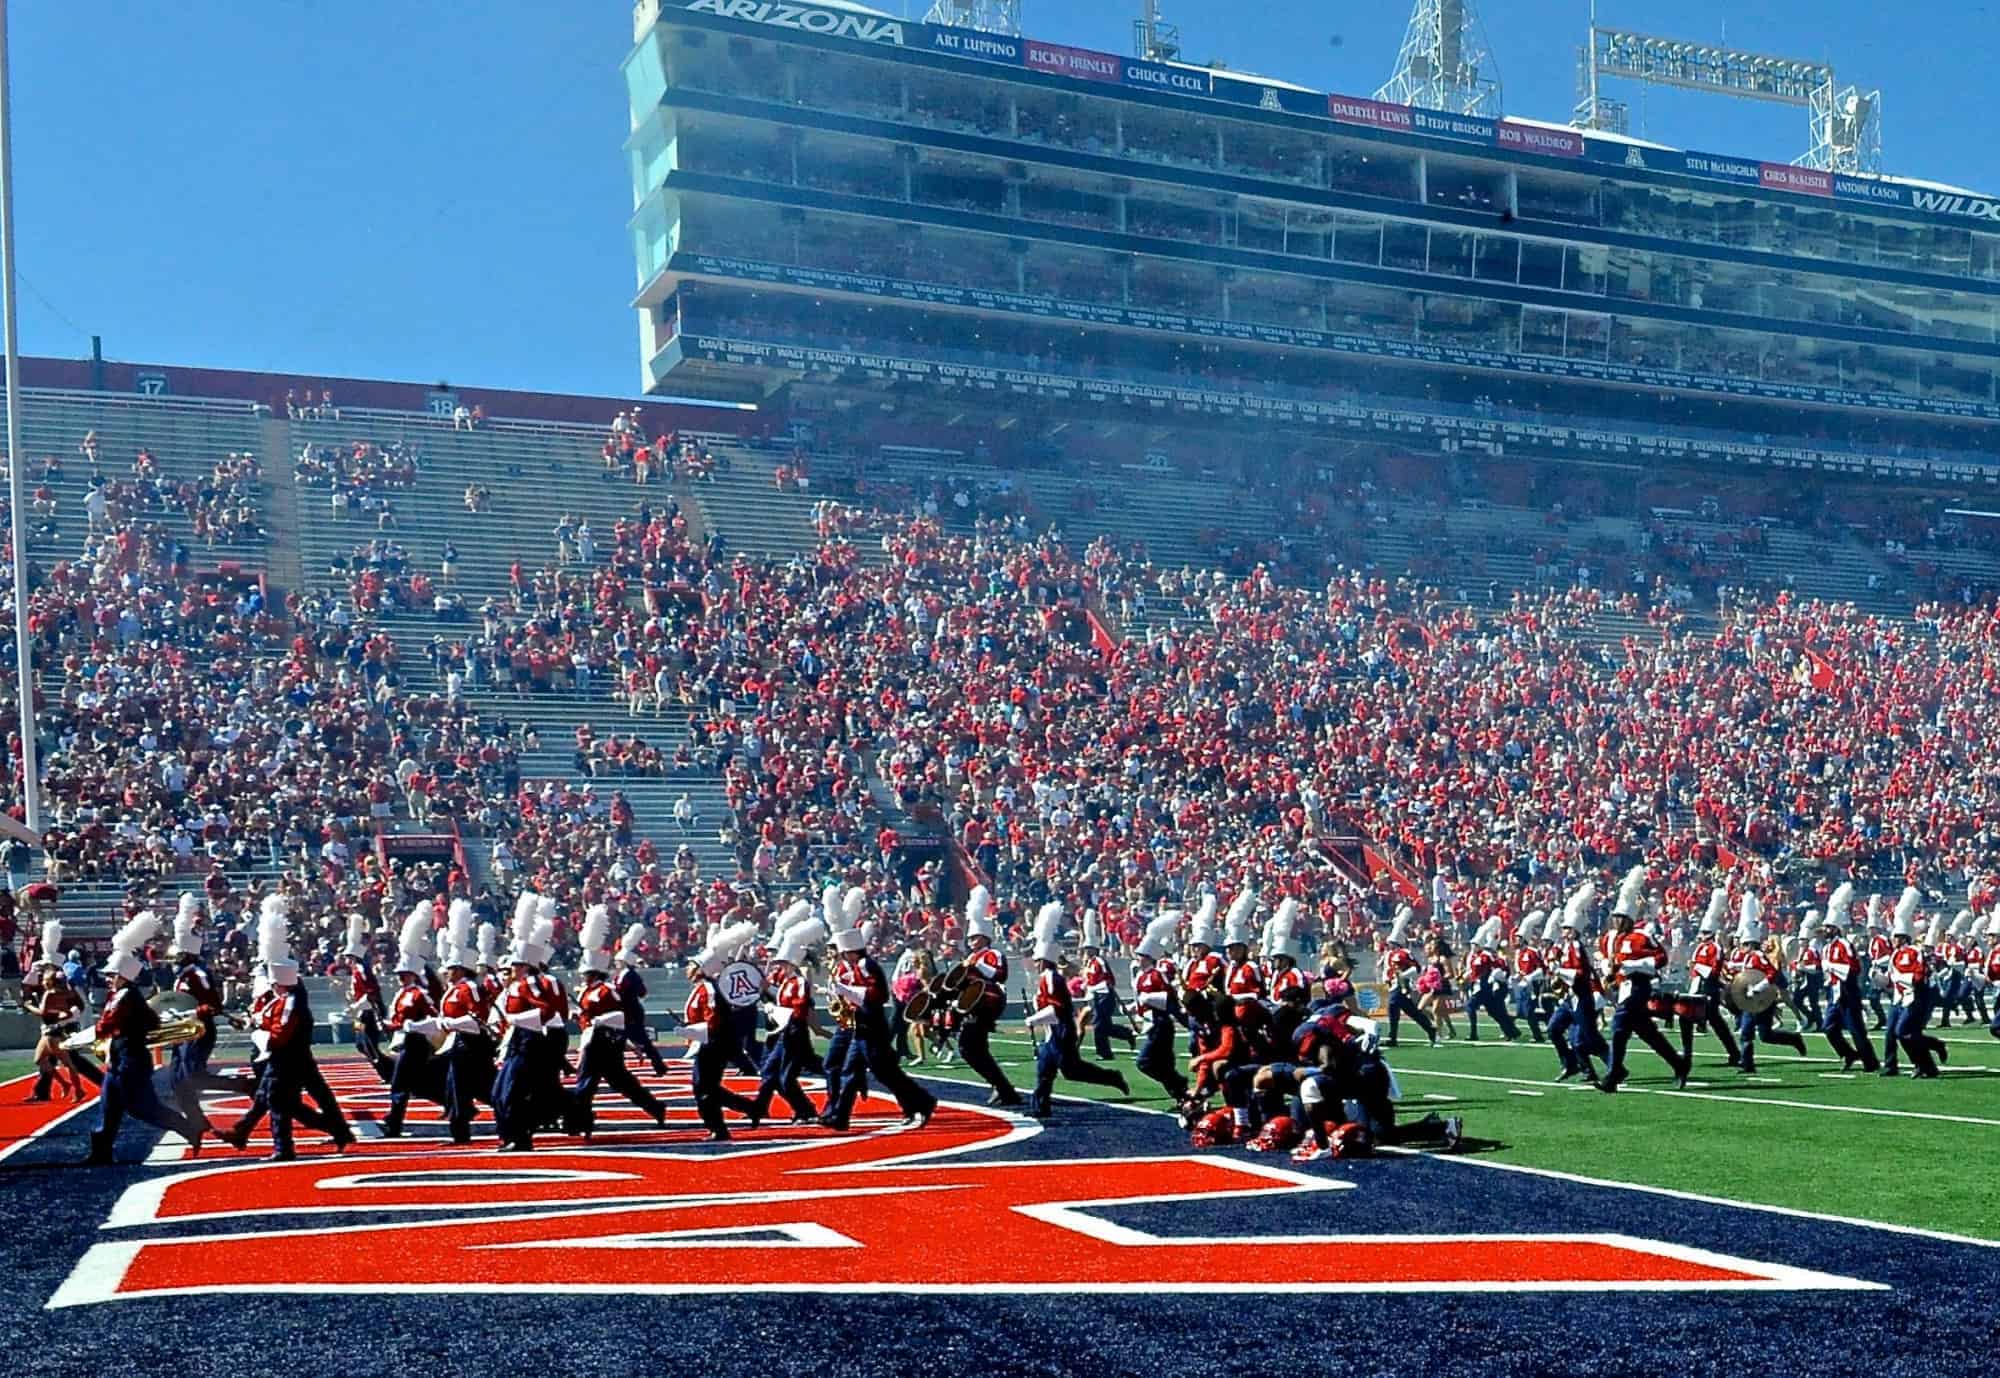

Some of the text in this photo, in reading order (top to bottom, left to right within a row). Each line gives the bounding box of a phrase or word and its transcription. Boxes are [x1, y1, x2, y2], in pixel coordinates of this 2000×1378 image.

[687, 0, 905, 45] ARIZONA
[935, 33, 1016, 58] ART LUPPINO
[1029, 49, 1065, 67] RICKY
[1127, 66, 1204, 92] CHUCK CECIL
[1380, 109, 1410, 126] LEWIS
[1523, 132, 1573, 151] WALDROP
[1686, 156, 1709, 171] STEVE
[1871, 185, 1900, 201] CASON
[141, 380, 165, 397] 17
[432, 400, 454, 416] 18
